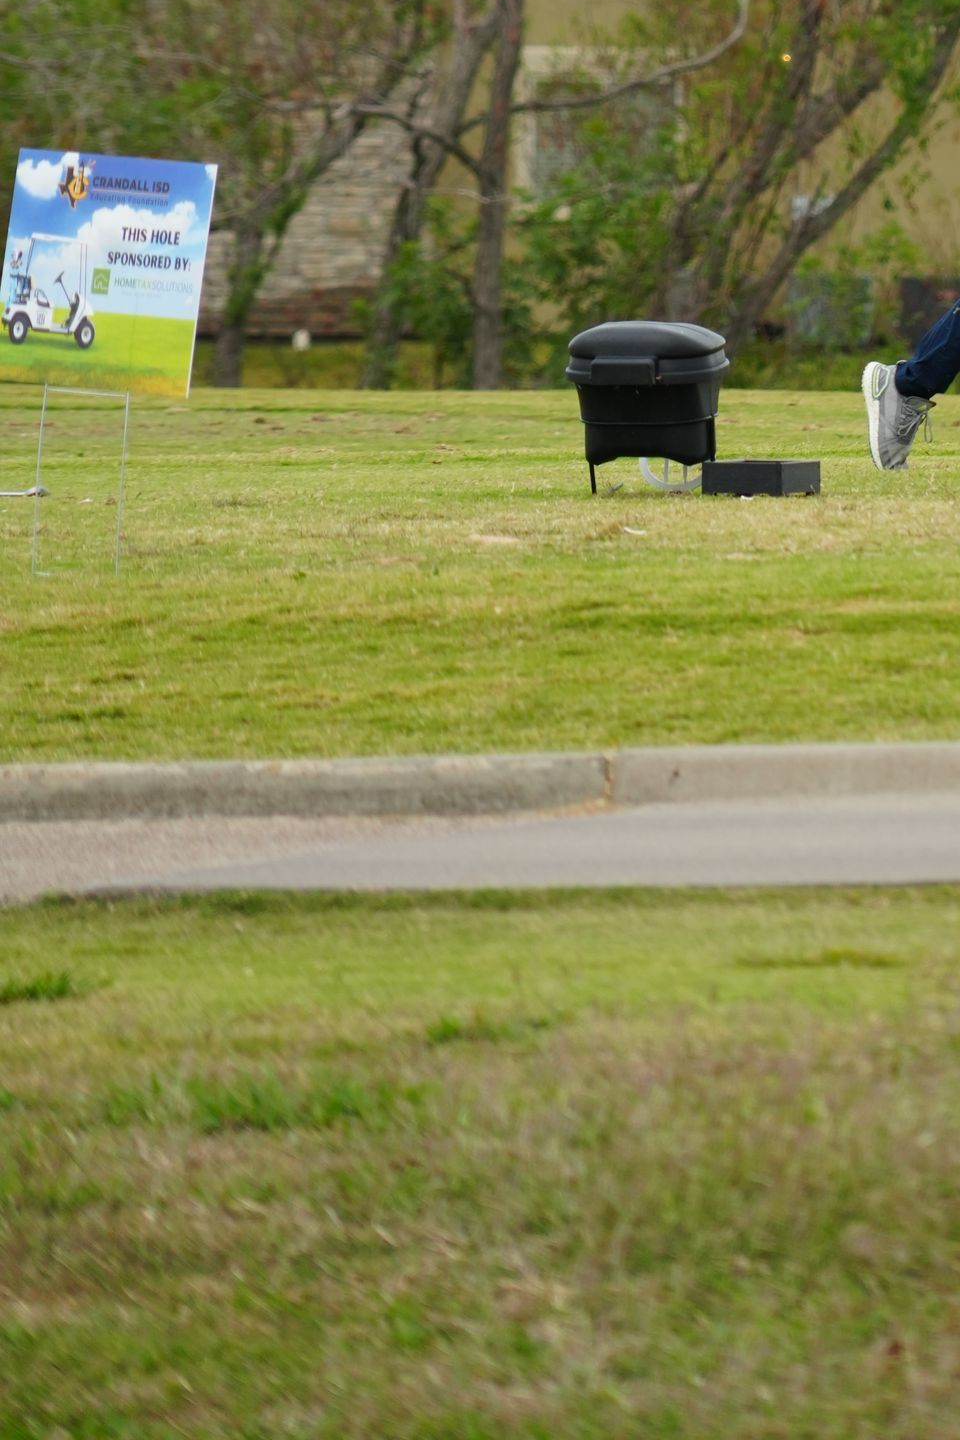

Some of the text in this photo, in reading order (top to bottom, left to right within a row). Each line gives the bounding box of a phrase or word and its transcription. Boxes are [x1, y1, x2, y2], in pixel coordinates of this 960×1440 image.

[92, 176, 170, 194] CRANDALL ISD
[122, 227, 180, 246] THIS HOLE
[107, 251, 191, 272] SPONSORED BY:
